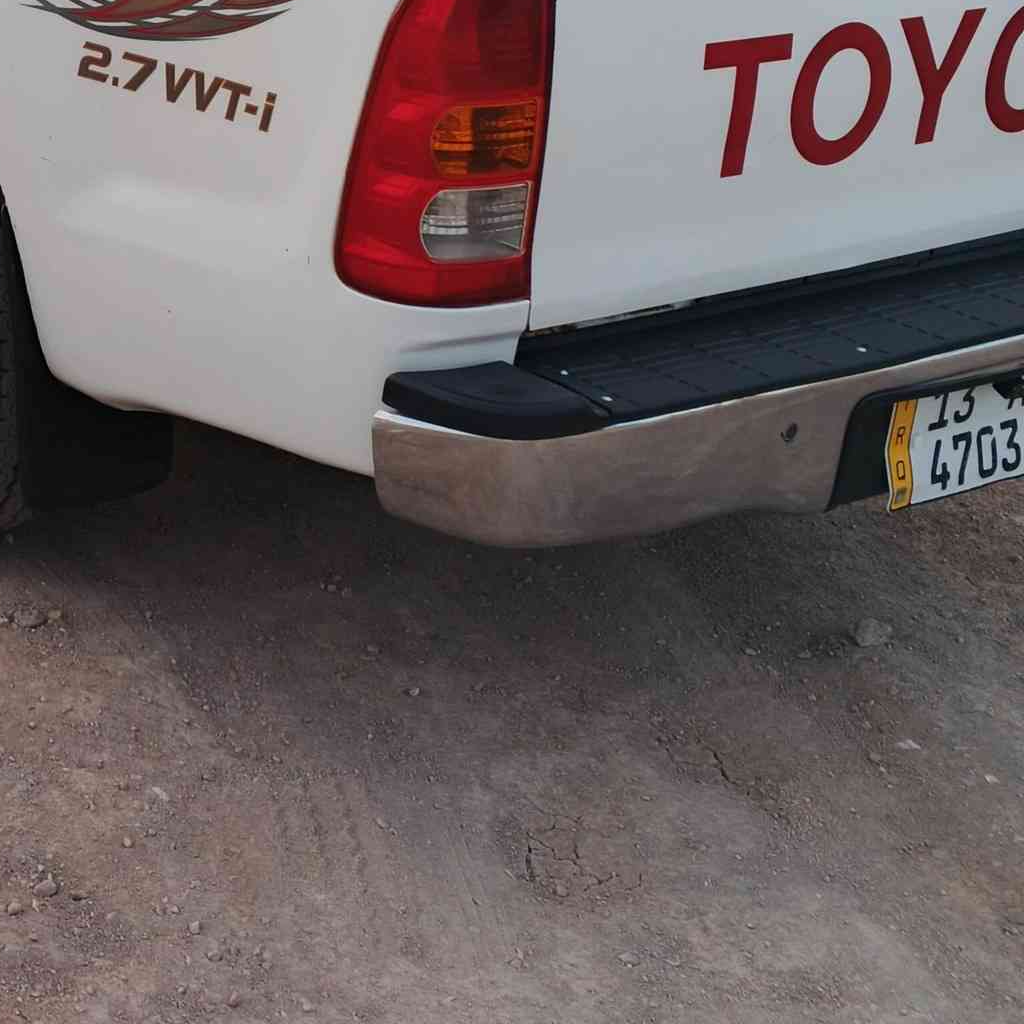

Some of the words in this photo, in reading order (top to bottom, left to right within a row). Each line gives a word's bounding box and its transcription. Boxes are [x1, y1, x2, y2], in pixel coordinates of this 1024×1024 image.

[78, 41, 157, 91] 2.7
[165, 62, 277, 132] VVT-i
[928, 387, 975, 431] 13
[931, 418, 1021, 490] 4703
